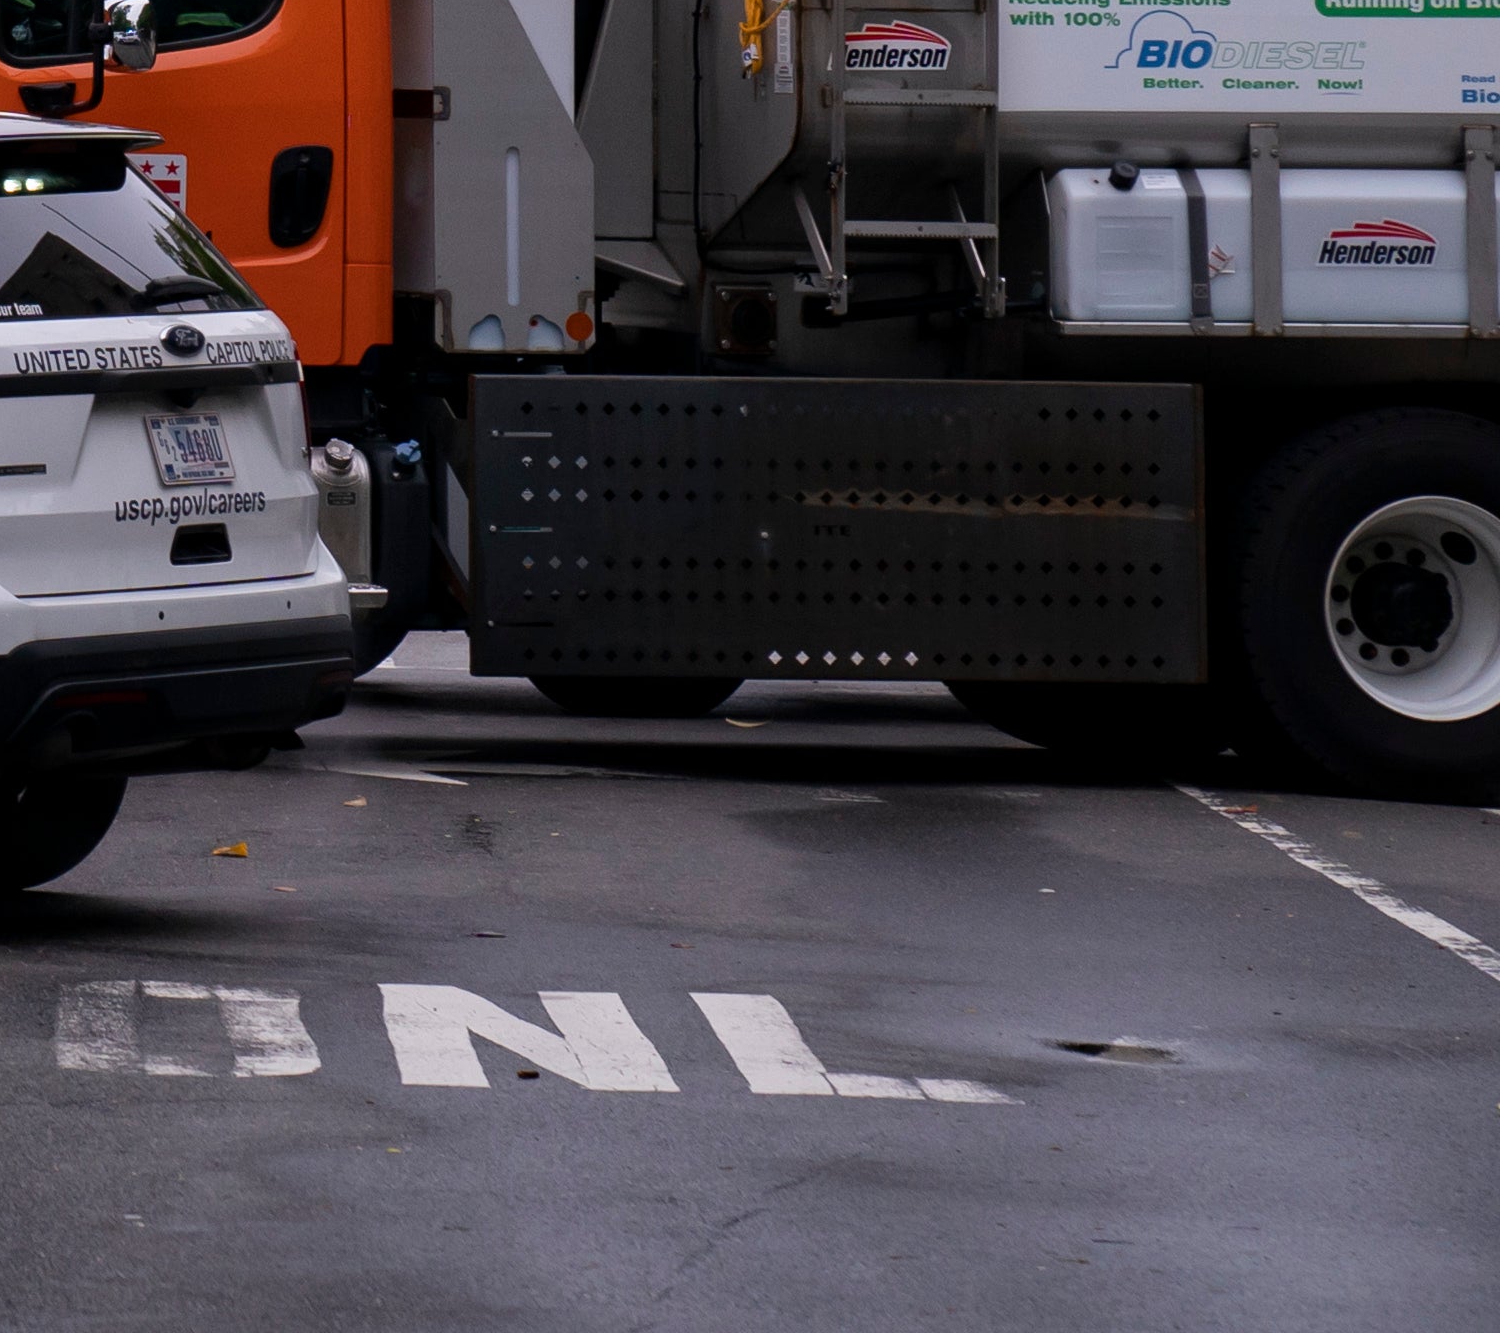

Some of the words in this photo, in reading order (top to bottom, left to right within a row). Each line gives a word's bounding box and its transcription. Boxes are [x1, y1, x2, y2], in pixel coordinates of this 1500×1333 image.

[1010, 11, 1054, 26] with
[1064, 11, 1121, 27] 100%
[845, 44, 949, 69] enderson
[1143, 77, 1204, 90] Better.
[1222, 77, 1300, 90] Cleaner.
[1318, 77, 1364, 90] Now!
[1461, 74, 1496, 84] Read
[1461, 89, 1500, 104] Bio
[1319, 240, 1436, 265] Henderson
[15, 303, 43, 316] team
[13, 348, 90, 375] UNITED
[95, 345, 163, 371] STATES
[206, 341, 260, 365] CAPITOL
[115, 487, 266, 526] uscp.gov/careers
